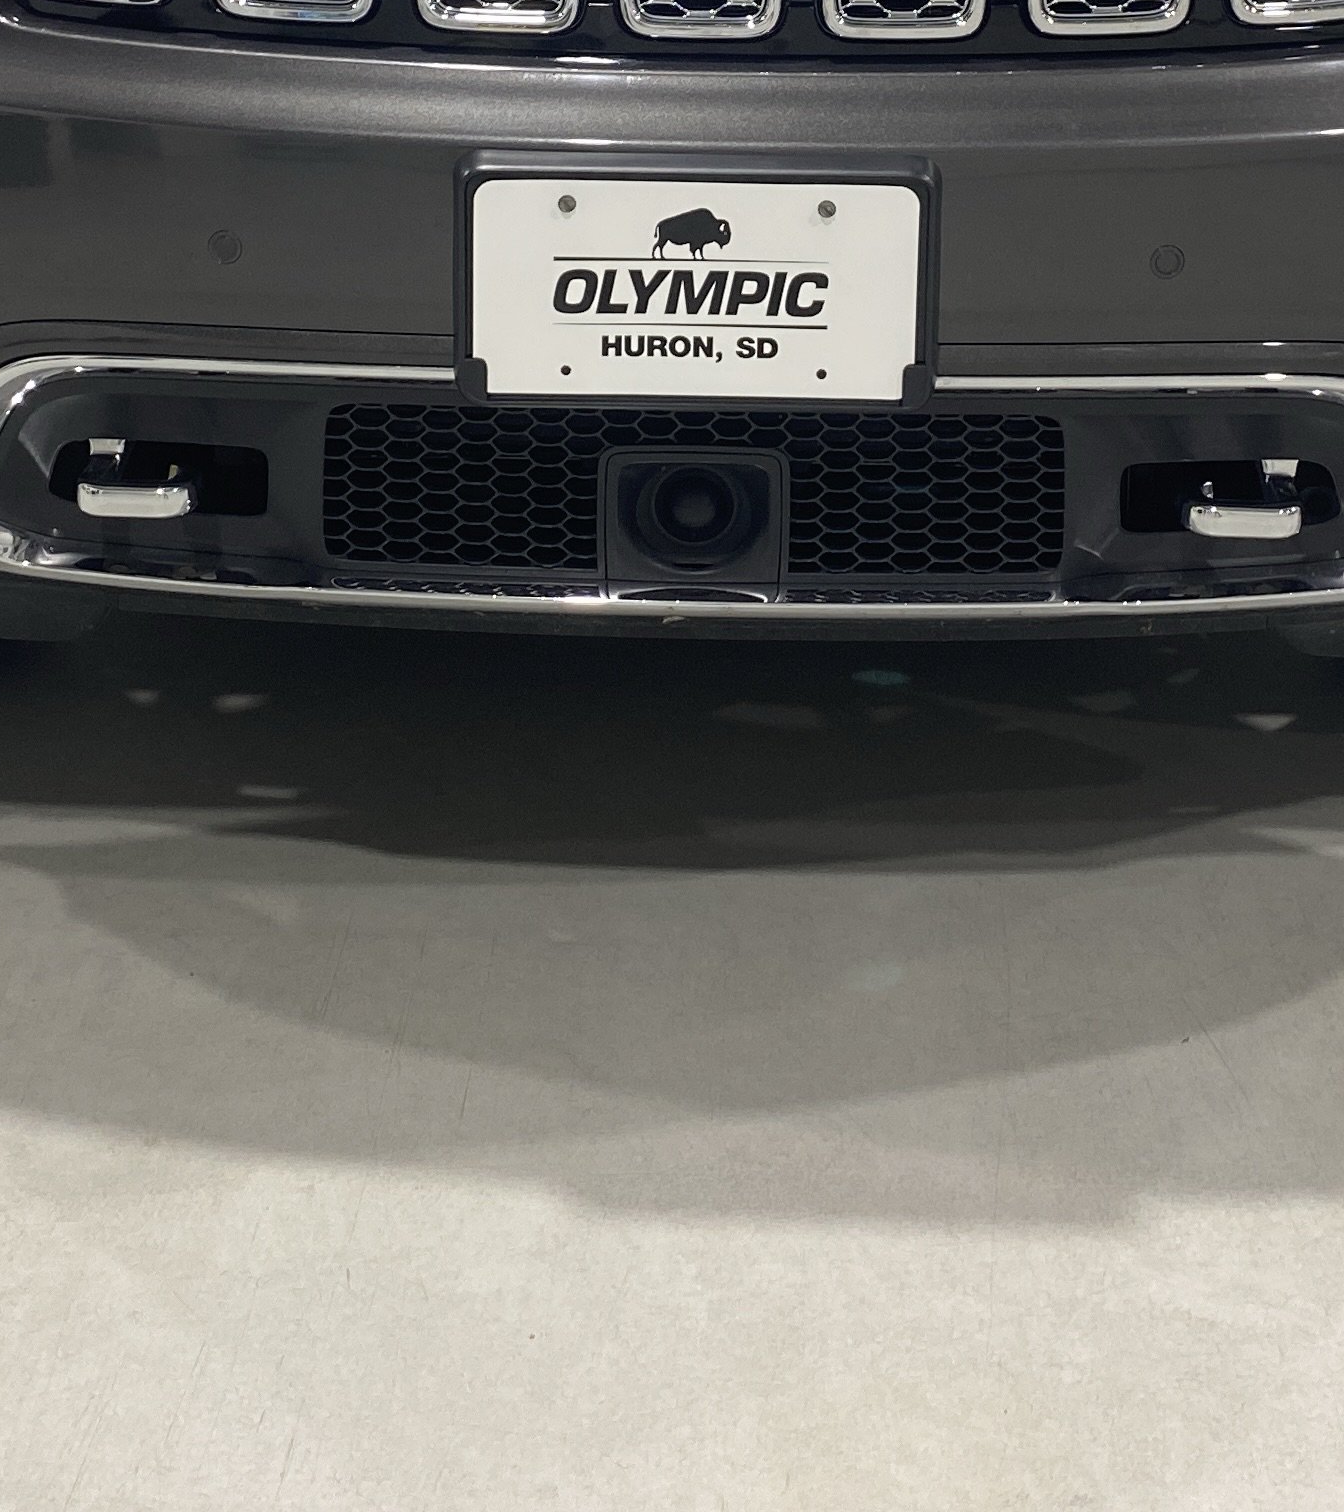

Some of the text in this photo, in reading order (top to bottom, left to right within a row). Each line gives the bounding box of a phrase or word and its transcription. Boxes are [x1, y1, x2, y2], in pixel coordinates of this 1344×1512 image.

[553, 269, 829, 317] OLYMPIC
[601, 335, 778, 362] HURON, SD
